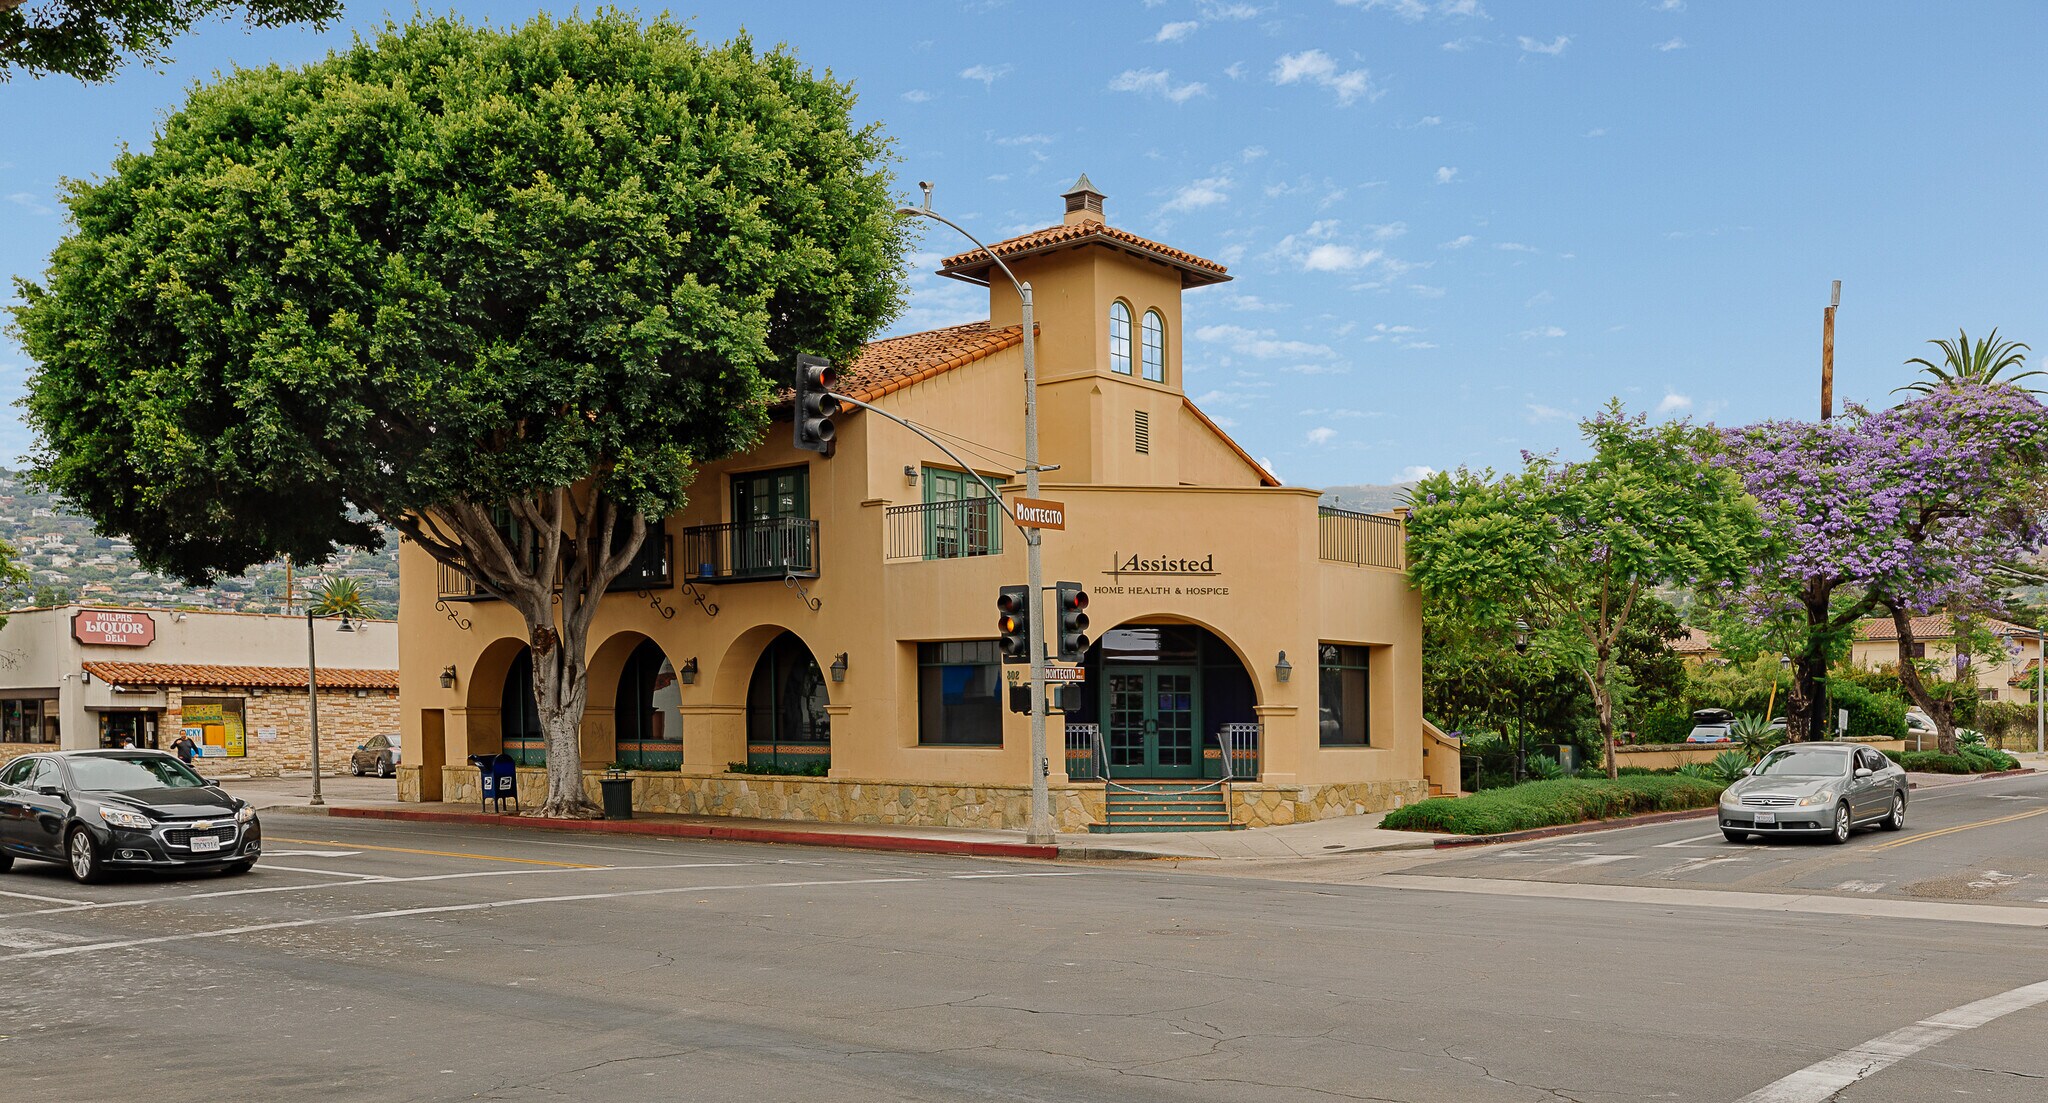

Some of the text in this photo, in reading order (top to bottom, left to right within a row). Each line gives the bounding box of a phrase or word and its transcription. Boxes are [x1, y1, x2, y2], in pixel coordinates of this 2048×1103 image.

[1016, 502, 1062, 525] MONTECITO
[1120, 553, 1214, 572] Assisted
[1094, 586, 1125, 595] HOME
[1128, 587, 1171, 595] HEALTH
[1186, 587, 1230, 596] HOSPICE
[96, 612, 133, 623] MILPAS
[85, 620, 144, 635] LIQUOR
[105, 634, 127, 643] DELI
[1045, 668, 1076, 680] MONTECITO
